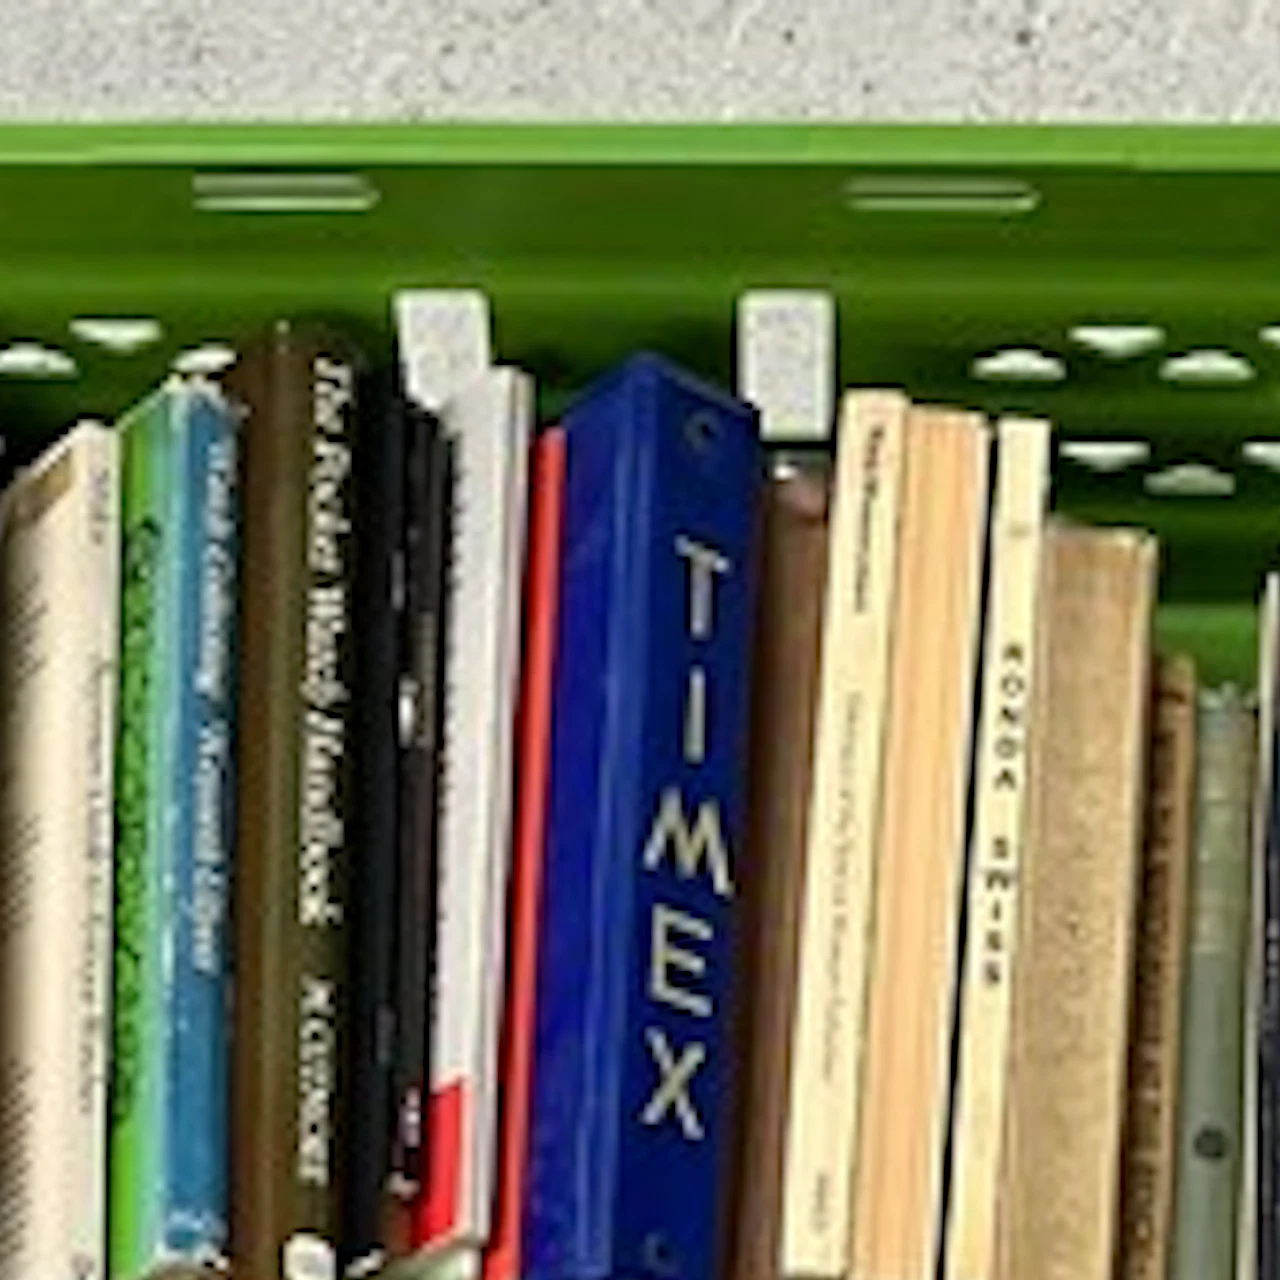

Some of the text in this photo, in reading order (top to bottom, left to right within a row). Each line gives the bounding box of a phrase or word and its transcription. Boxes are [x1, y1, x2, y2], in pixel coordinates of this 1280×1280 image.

[312, 355, 354, 428] The
[297, 708, 346, 929] Handbook
[640, 533, 737, 1142] TIMEX
